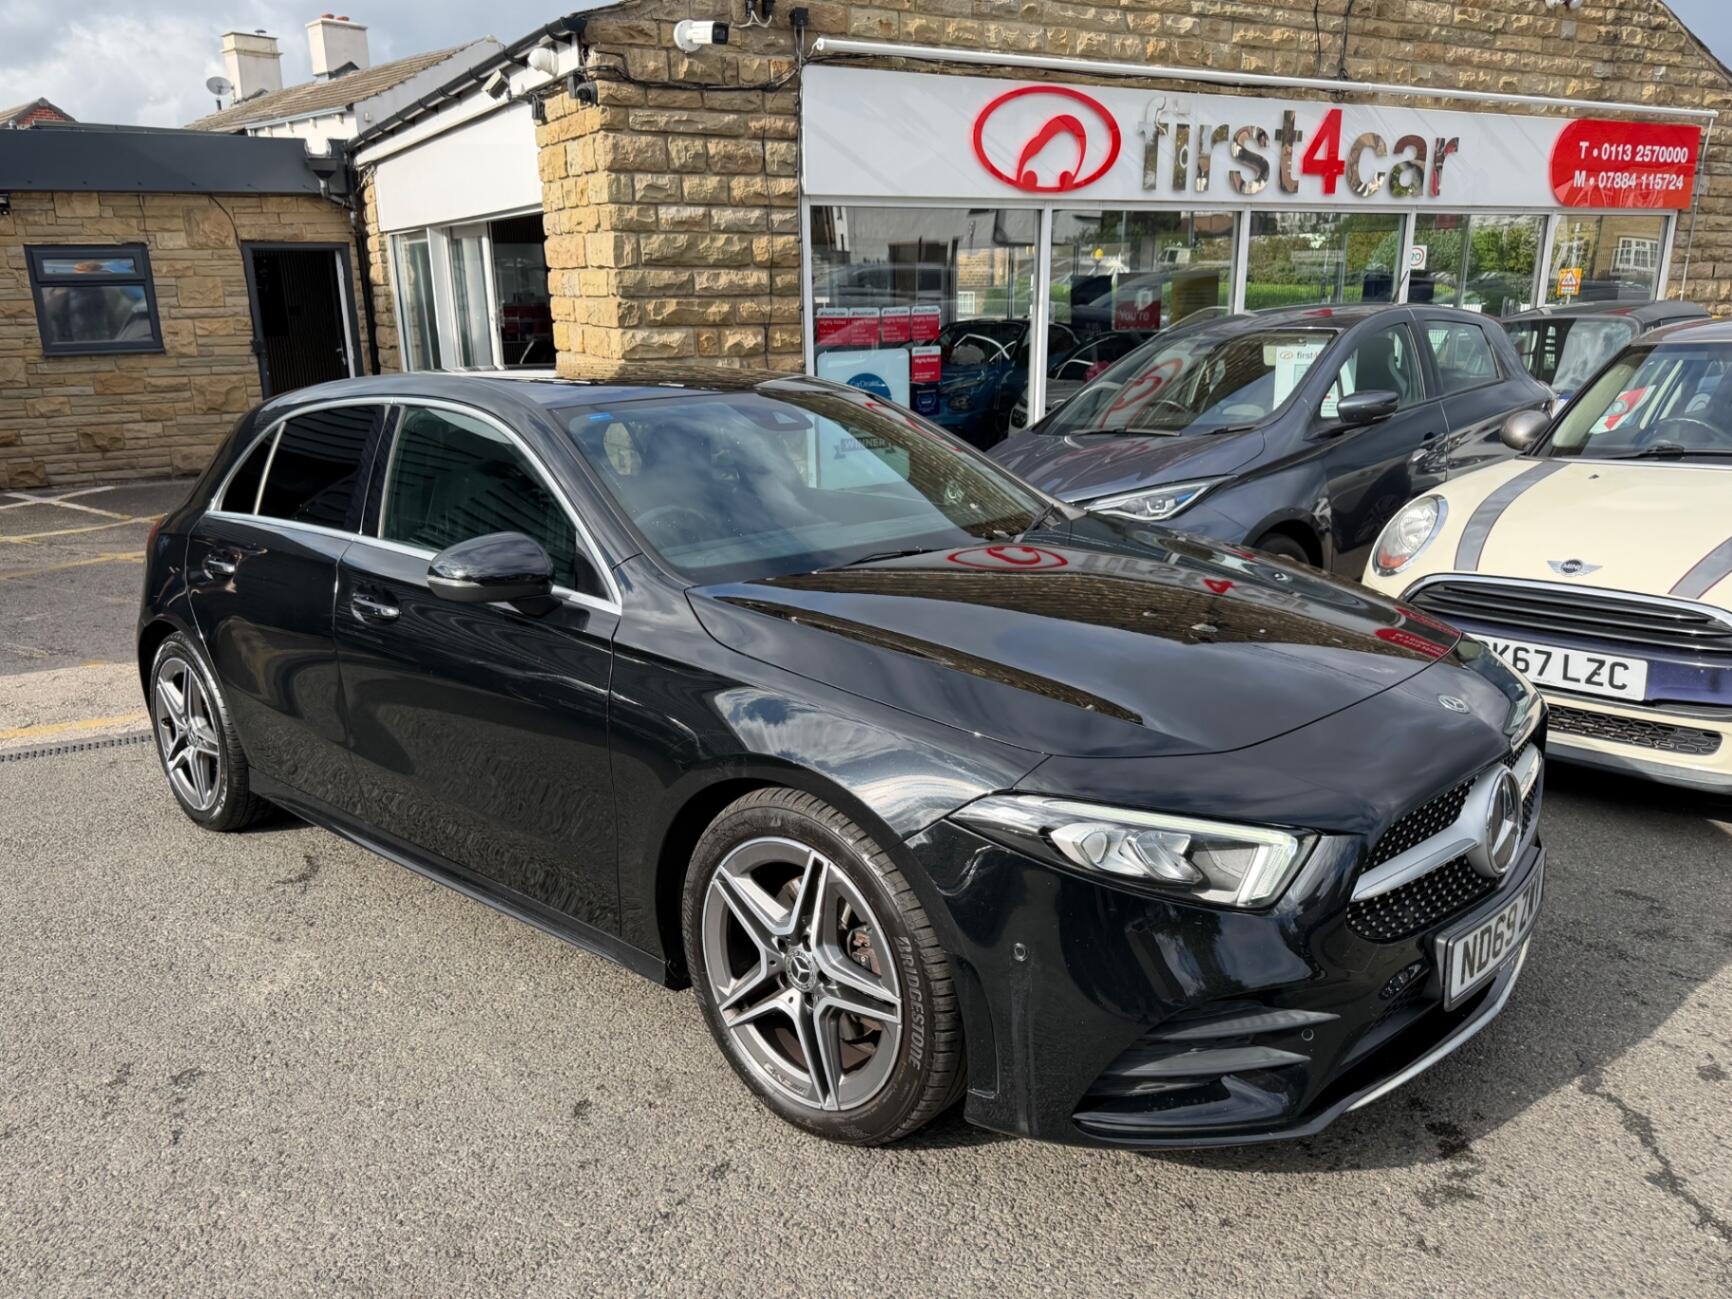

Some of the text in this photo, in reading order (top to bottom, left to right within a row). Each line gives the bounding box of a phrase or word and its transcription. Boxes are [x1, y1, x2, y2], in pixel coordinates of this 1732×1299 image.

[1138, 96, 1460, 198] first4car
[1579, 141, 1689, 164] T 0113 2570000
[1573, 170, 1685, 190] M 07884 115724
[1561, 654, 1630, 690] LZC
[1460, 902, 1518, 987] ND69
